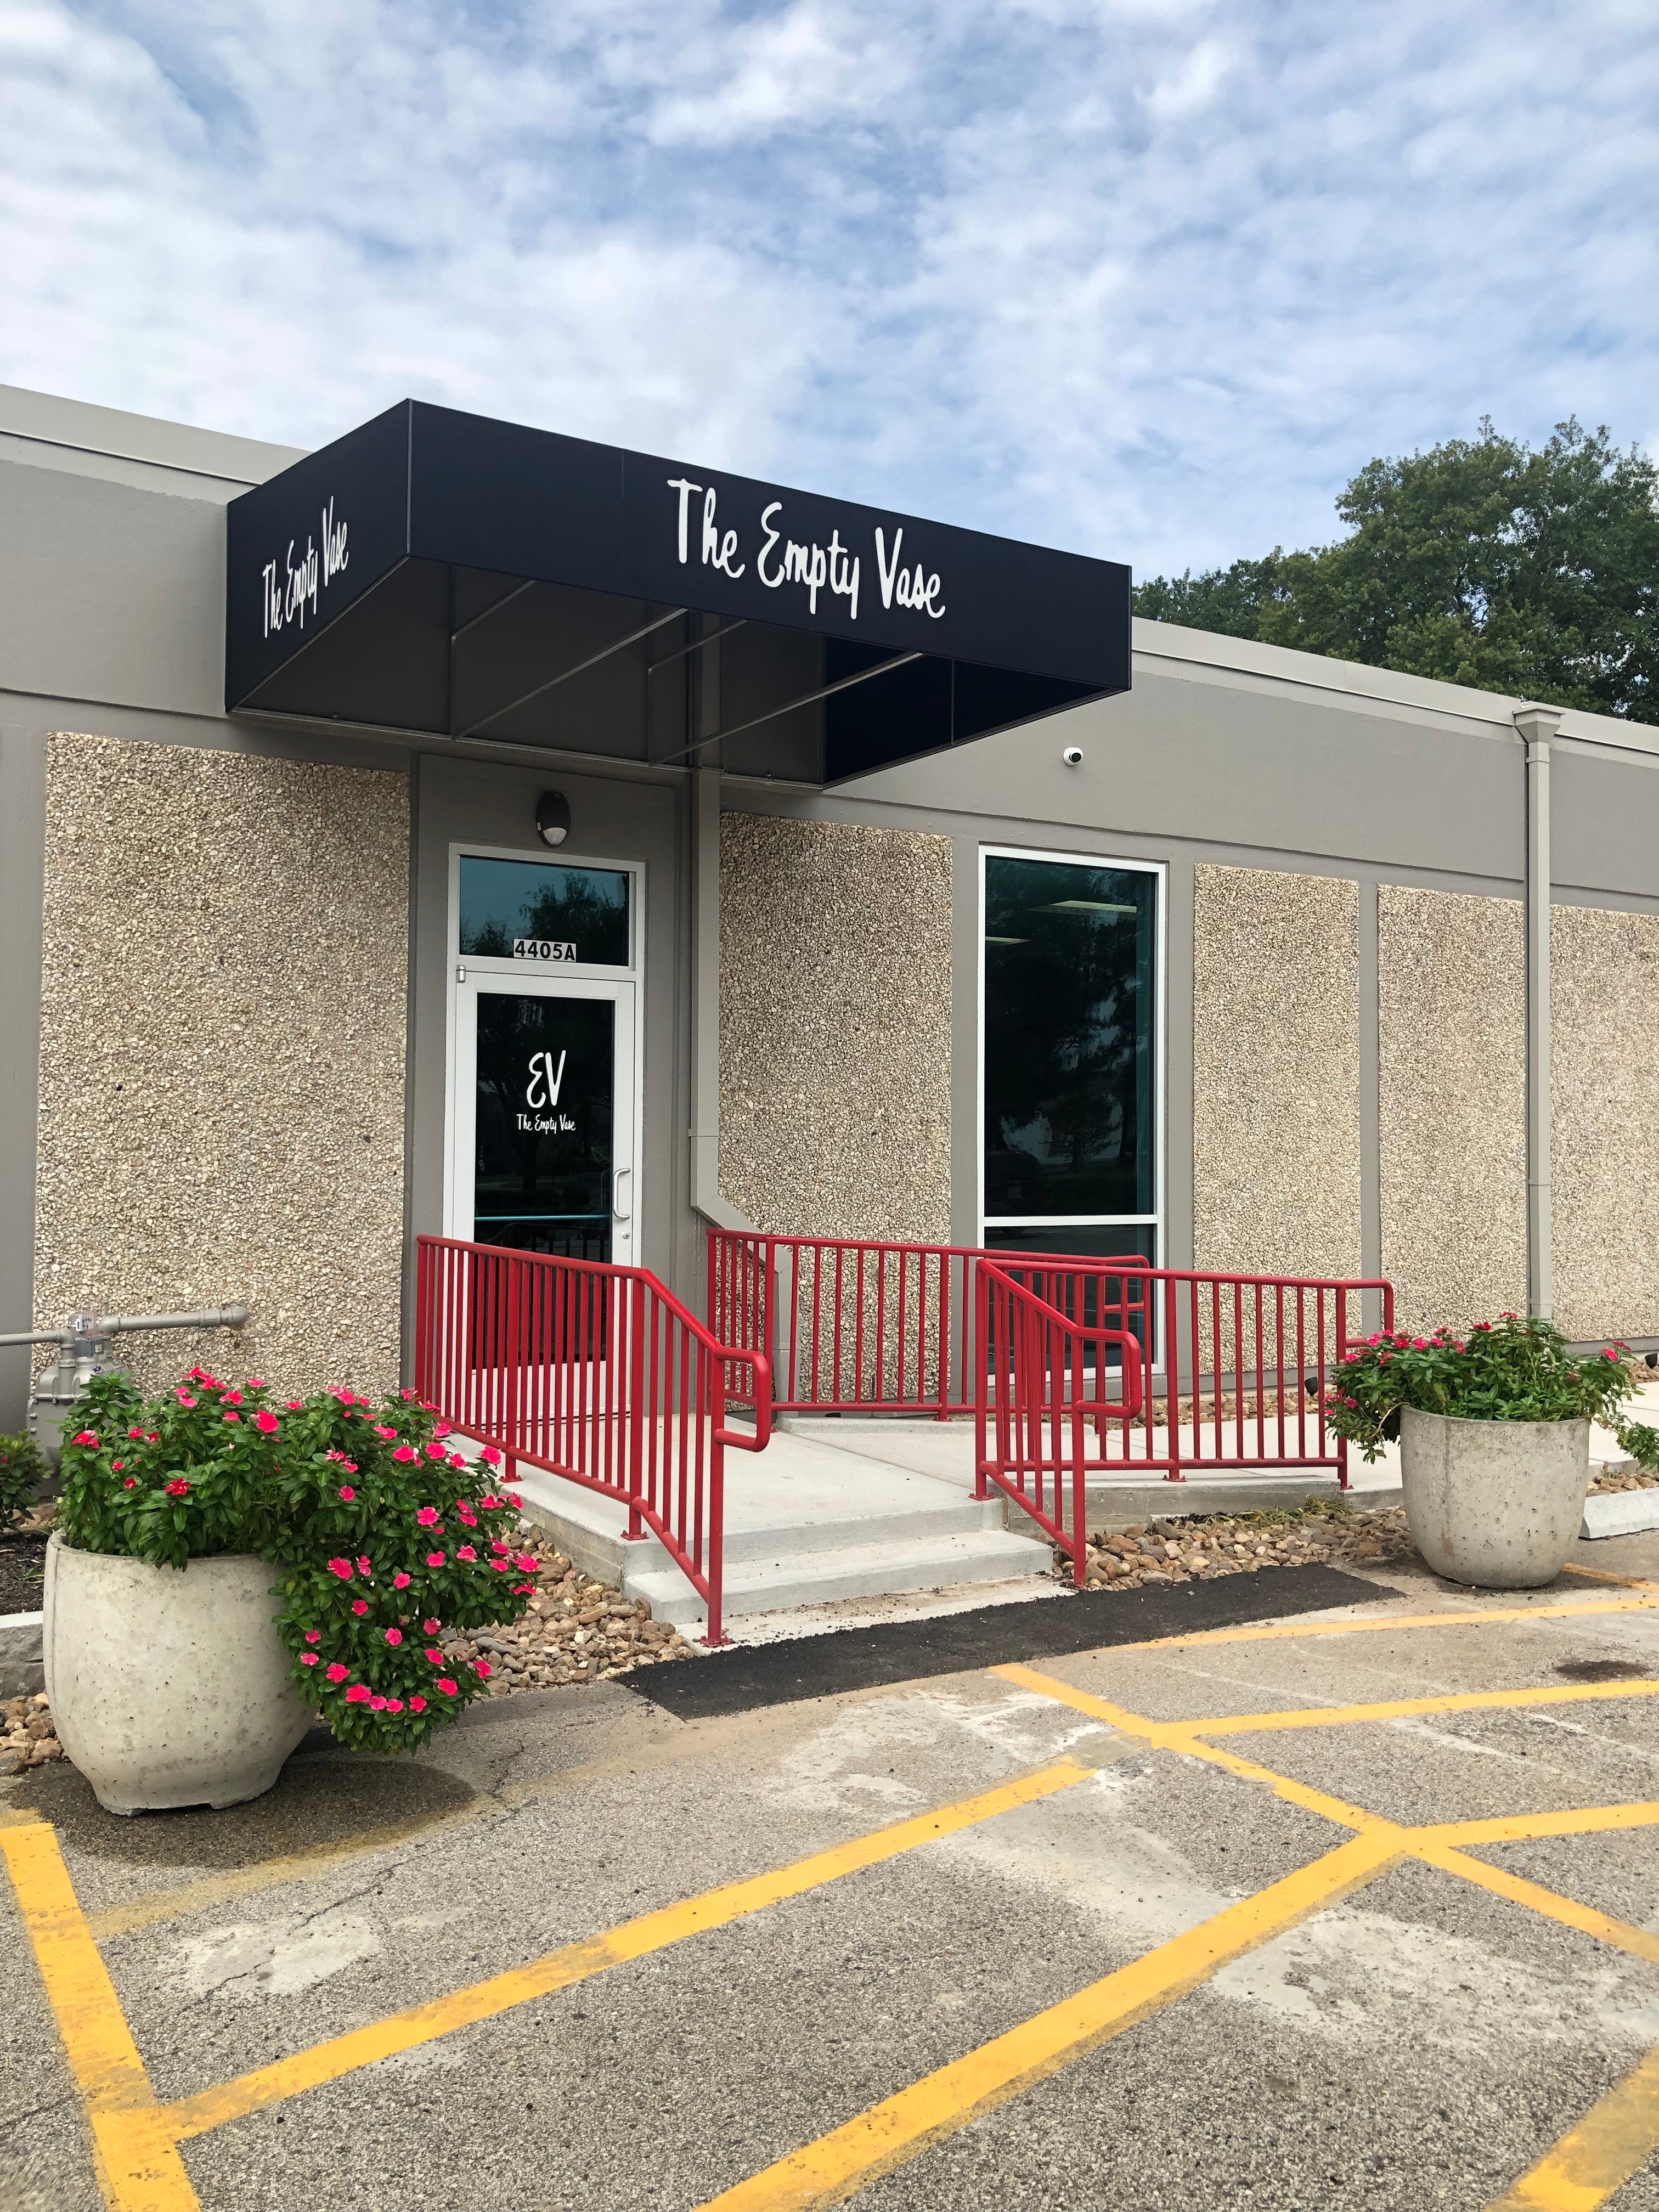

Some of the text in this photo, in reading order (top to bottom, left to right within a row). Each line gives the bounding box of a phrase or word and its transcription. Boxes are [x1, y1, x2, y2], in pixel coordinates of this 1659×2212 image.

[262, 495, 349, 639] The Empty Vase
[667, 478, 946, 620] The Empty Vase
[515, 940, 575, 961] 4405A
[527, 1049, 566, 1108] EV
[516, 1113, 576, 1135] The Empty Vase
